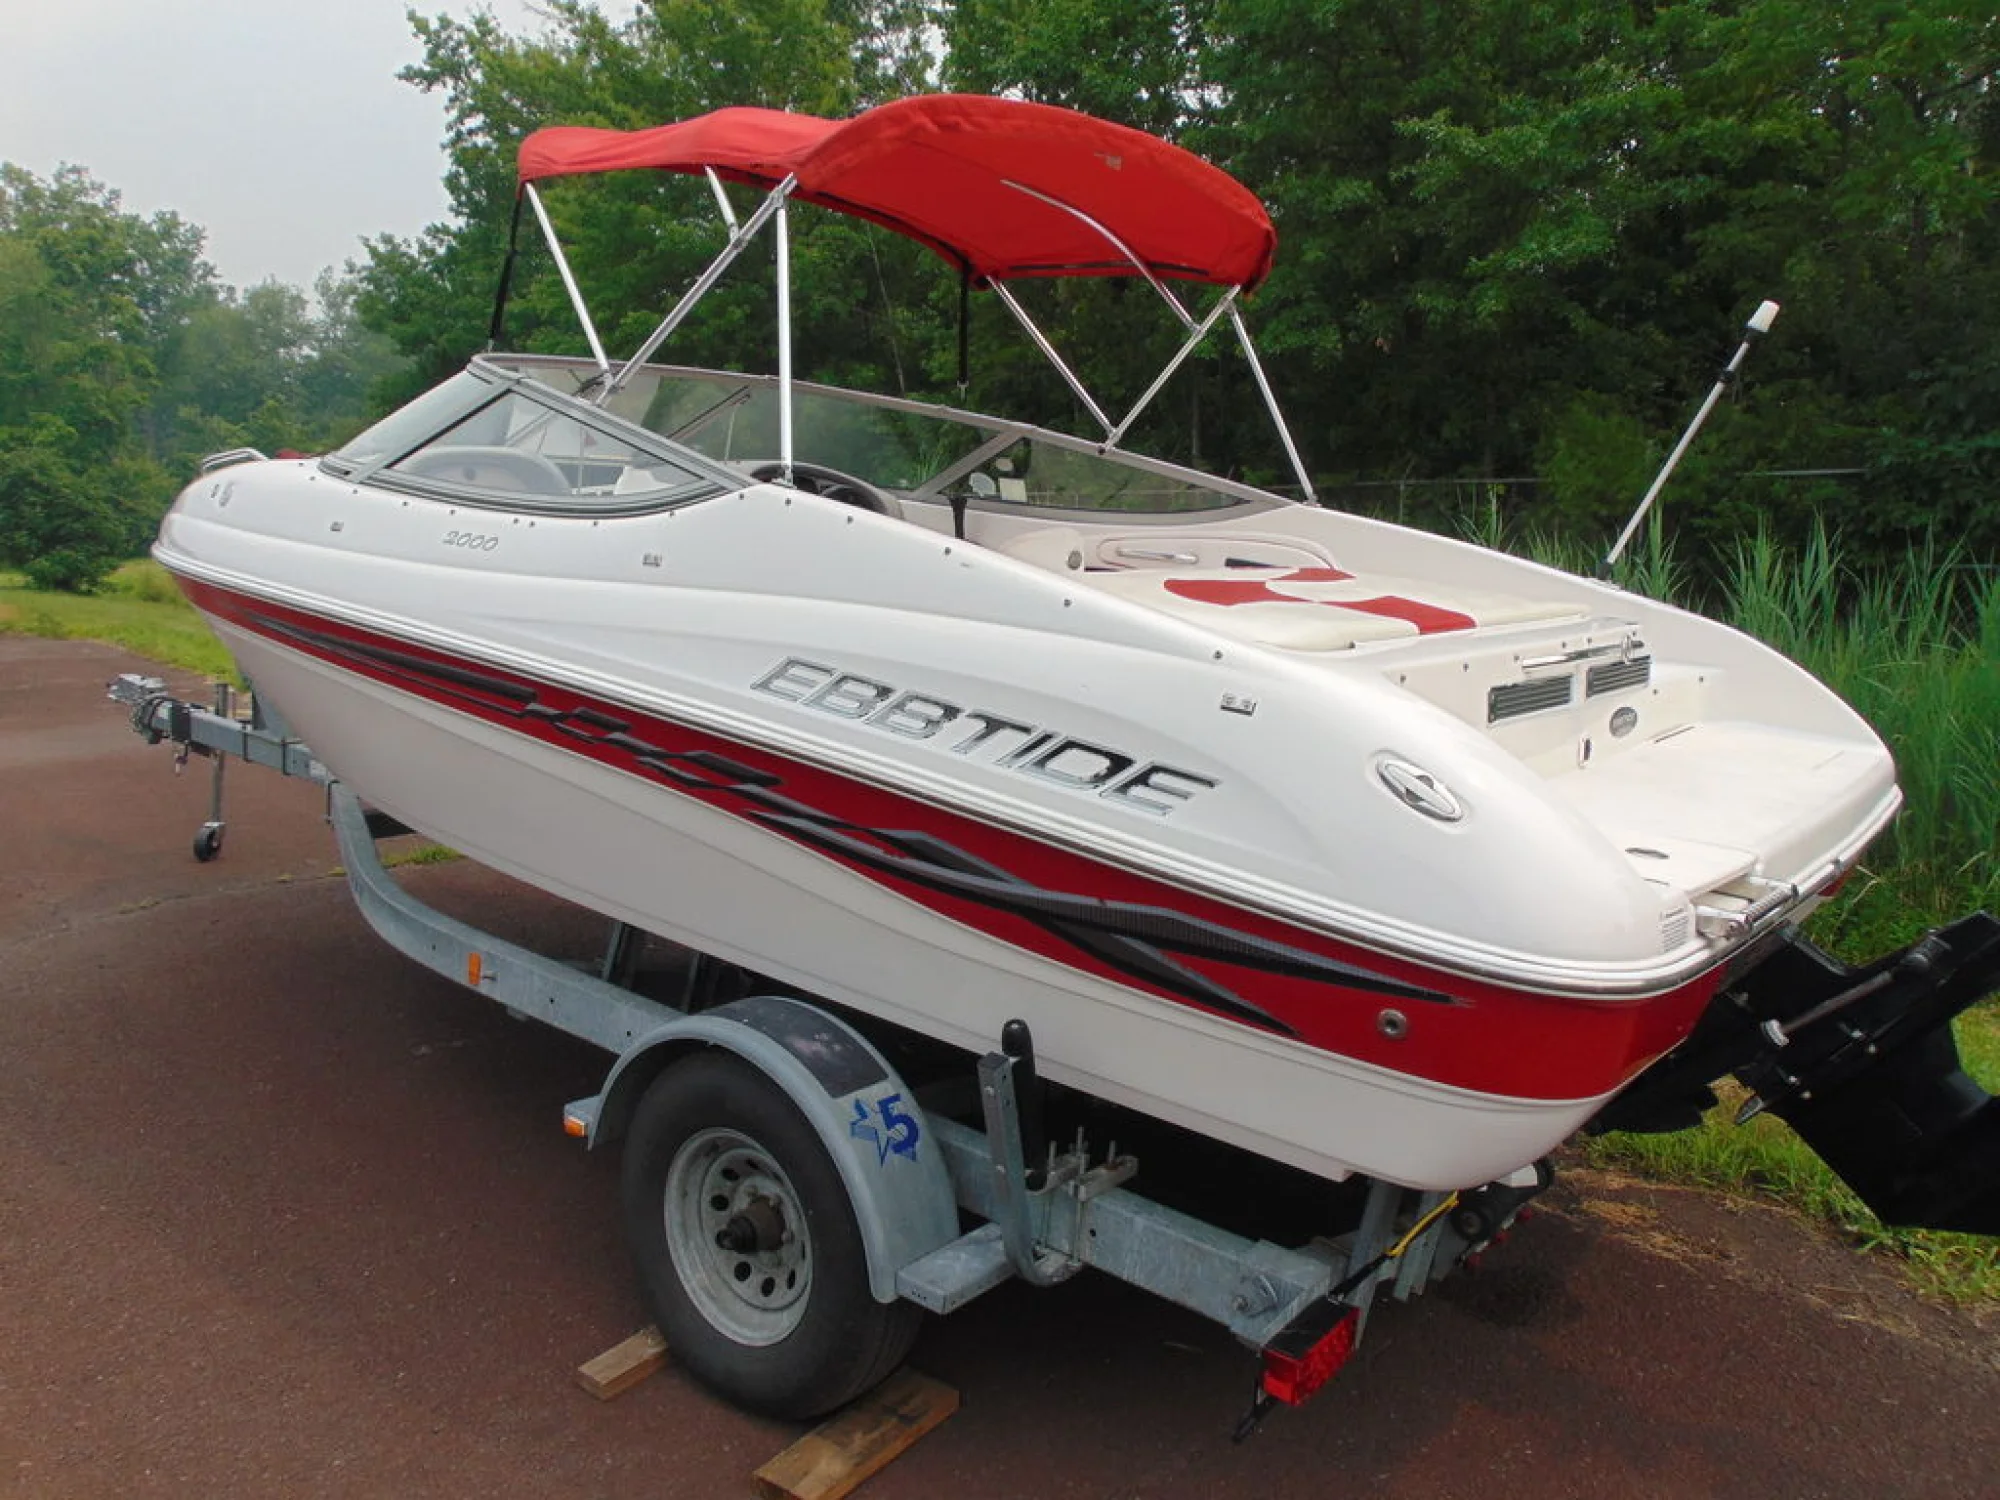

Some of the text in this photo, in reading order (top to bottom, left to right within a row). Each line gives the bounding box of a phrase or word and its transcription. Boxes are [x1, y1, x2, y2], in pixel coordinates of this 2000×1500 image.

[442, 530, 499, 551] 2000
[750, 656, 1219, 817] EBBTIDE
[878, 1093, 918, 1154] 5
